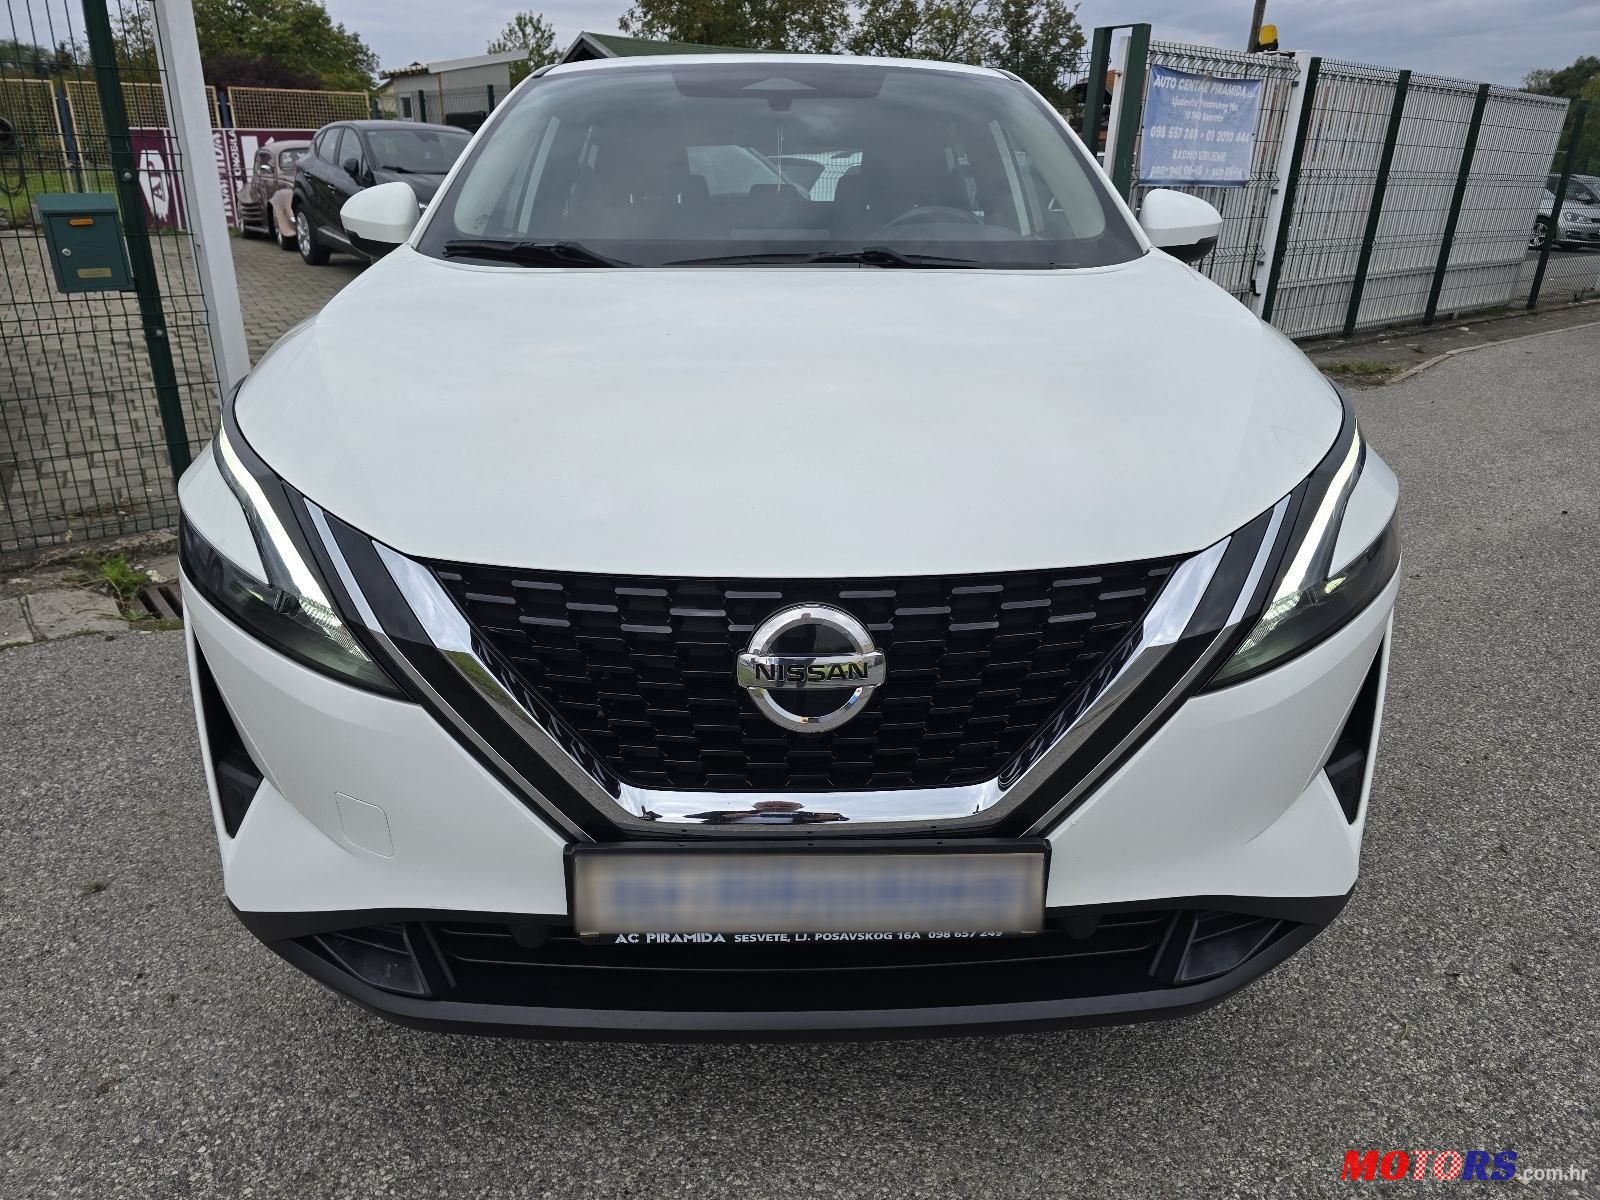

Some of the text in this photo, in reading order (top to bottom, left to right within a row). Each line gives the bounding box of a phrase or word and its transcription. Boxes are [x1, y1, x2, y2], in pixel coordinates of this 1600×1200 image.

[1153, 75, 1176, 89] AUTO
[1178, 78, 1209, 94] CENTAR
[1210, 82, 1246, 98] PIRAMIDA
[755, 662, 868, 682] NISSAN
[614, 932, 639, 944] AC
[646, 932, 727, 944] PIRAMIDA
[734, 933, 791, 943] SESVETE,
[815, 932, 893, 941] POSAVSKOG
[897, 931, 921, 940] 16A
[928, 930, 951, 939] 098
